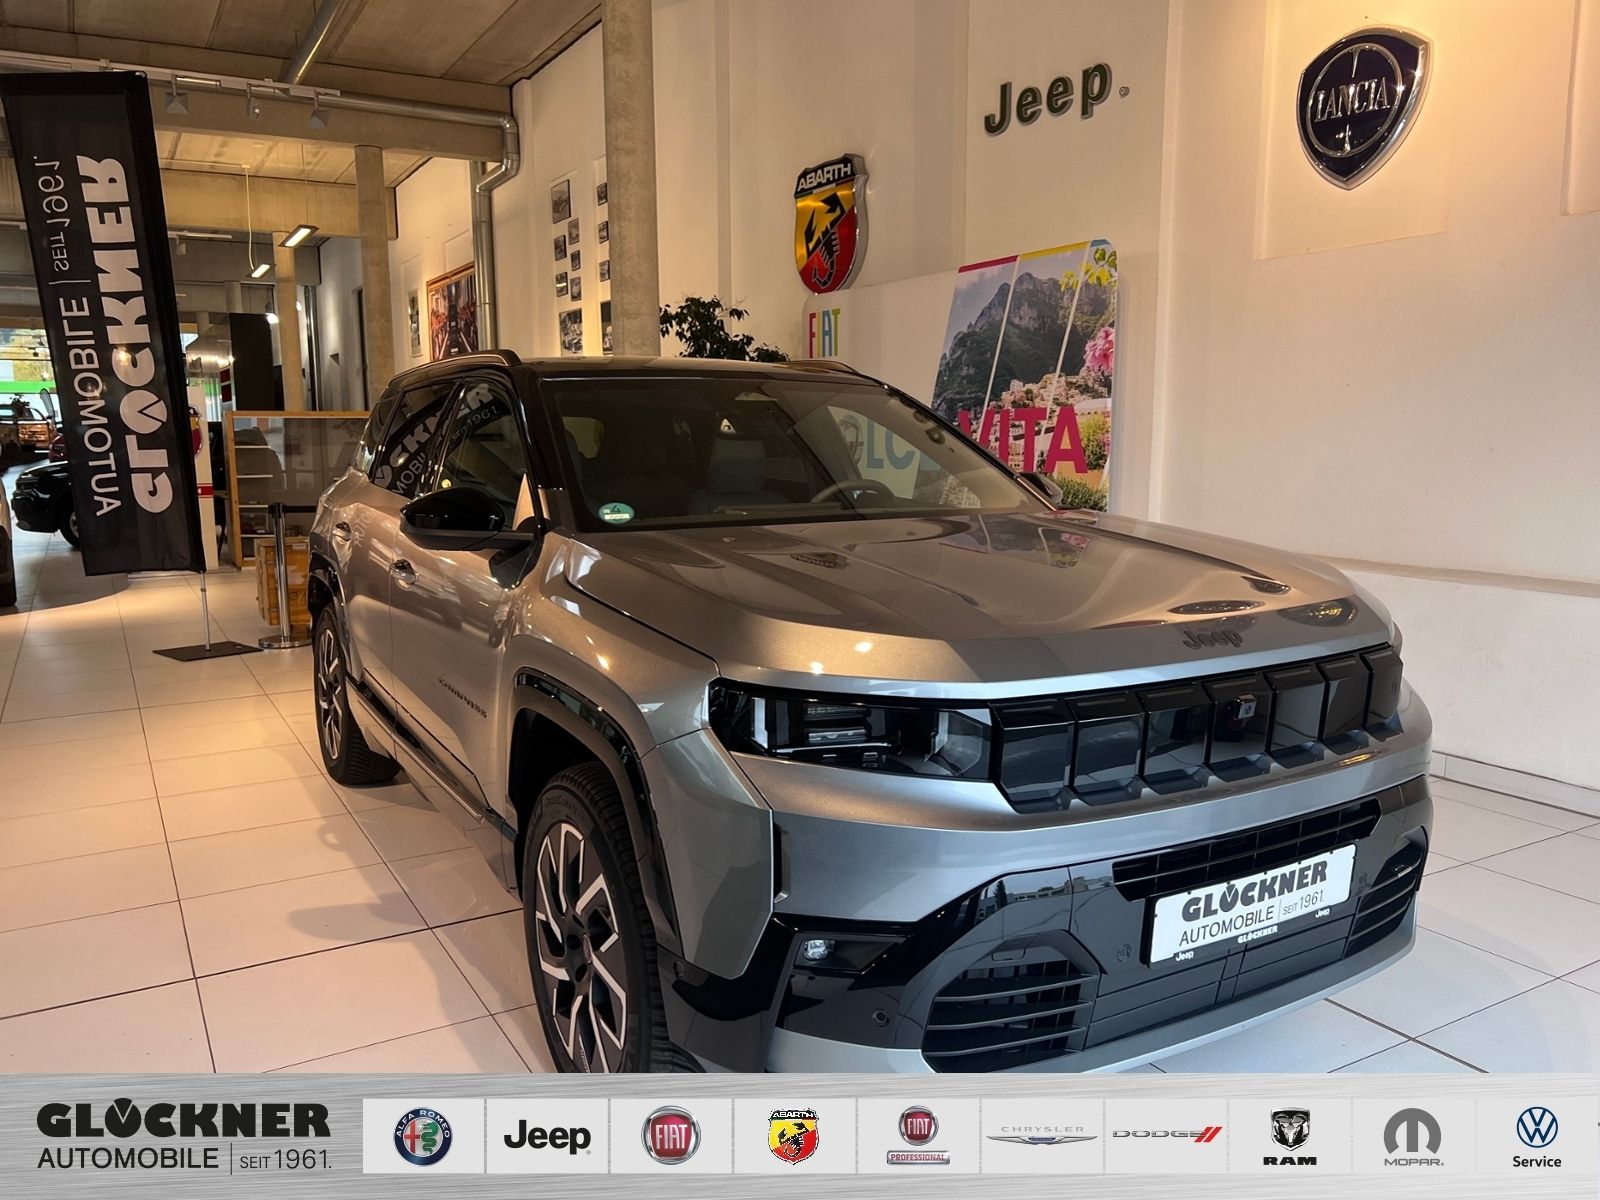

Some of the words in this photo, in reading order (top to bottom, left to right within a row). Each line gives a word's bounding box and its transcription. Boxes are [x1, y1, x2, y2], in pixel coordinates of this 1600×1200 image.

[984, 63, 1112, 137] Jeep
[1313, 76, 1391, 122] LANCIA
[797, 162, 852, 192] ABARTH
[808, 308, 841, 359] FIAT
[1182, 629, 1243, 650] Jeep
[1179, 904, 1275, 947] AUTOMOBILE
[1282, 902, 1299, 915] SEIT
[1315, 907, 1331, 918] Jeep
[1175, 950, 1194, 962] Jeep
